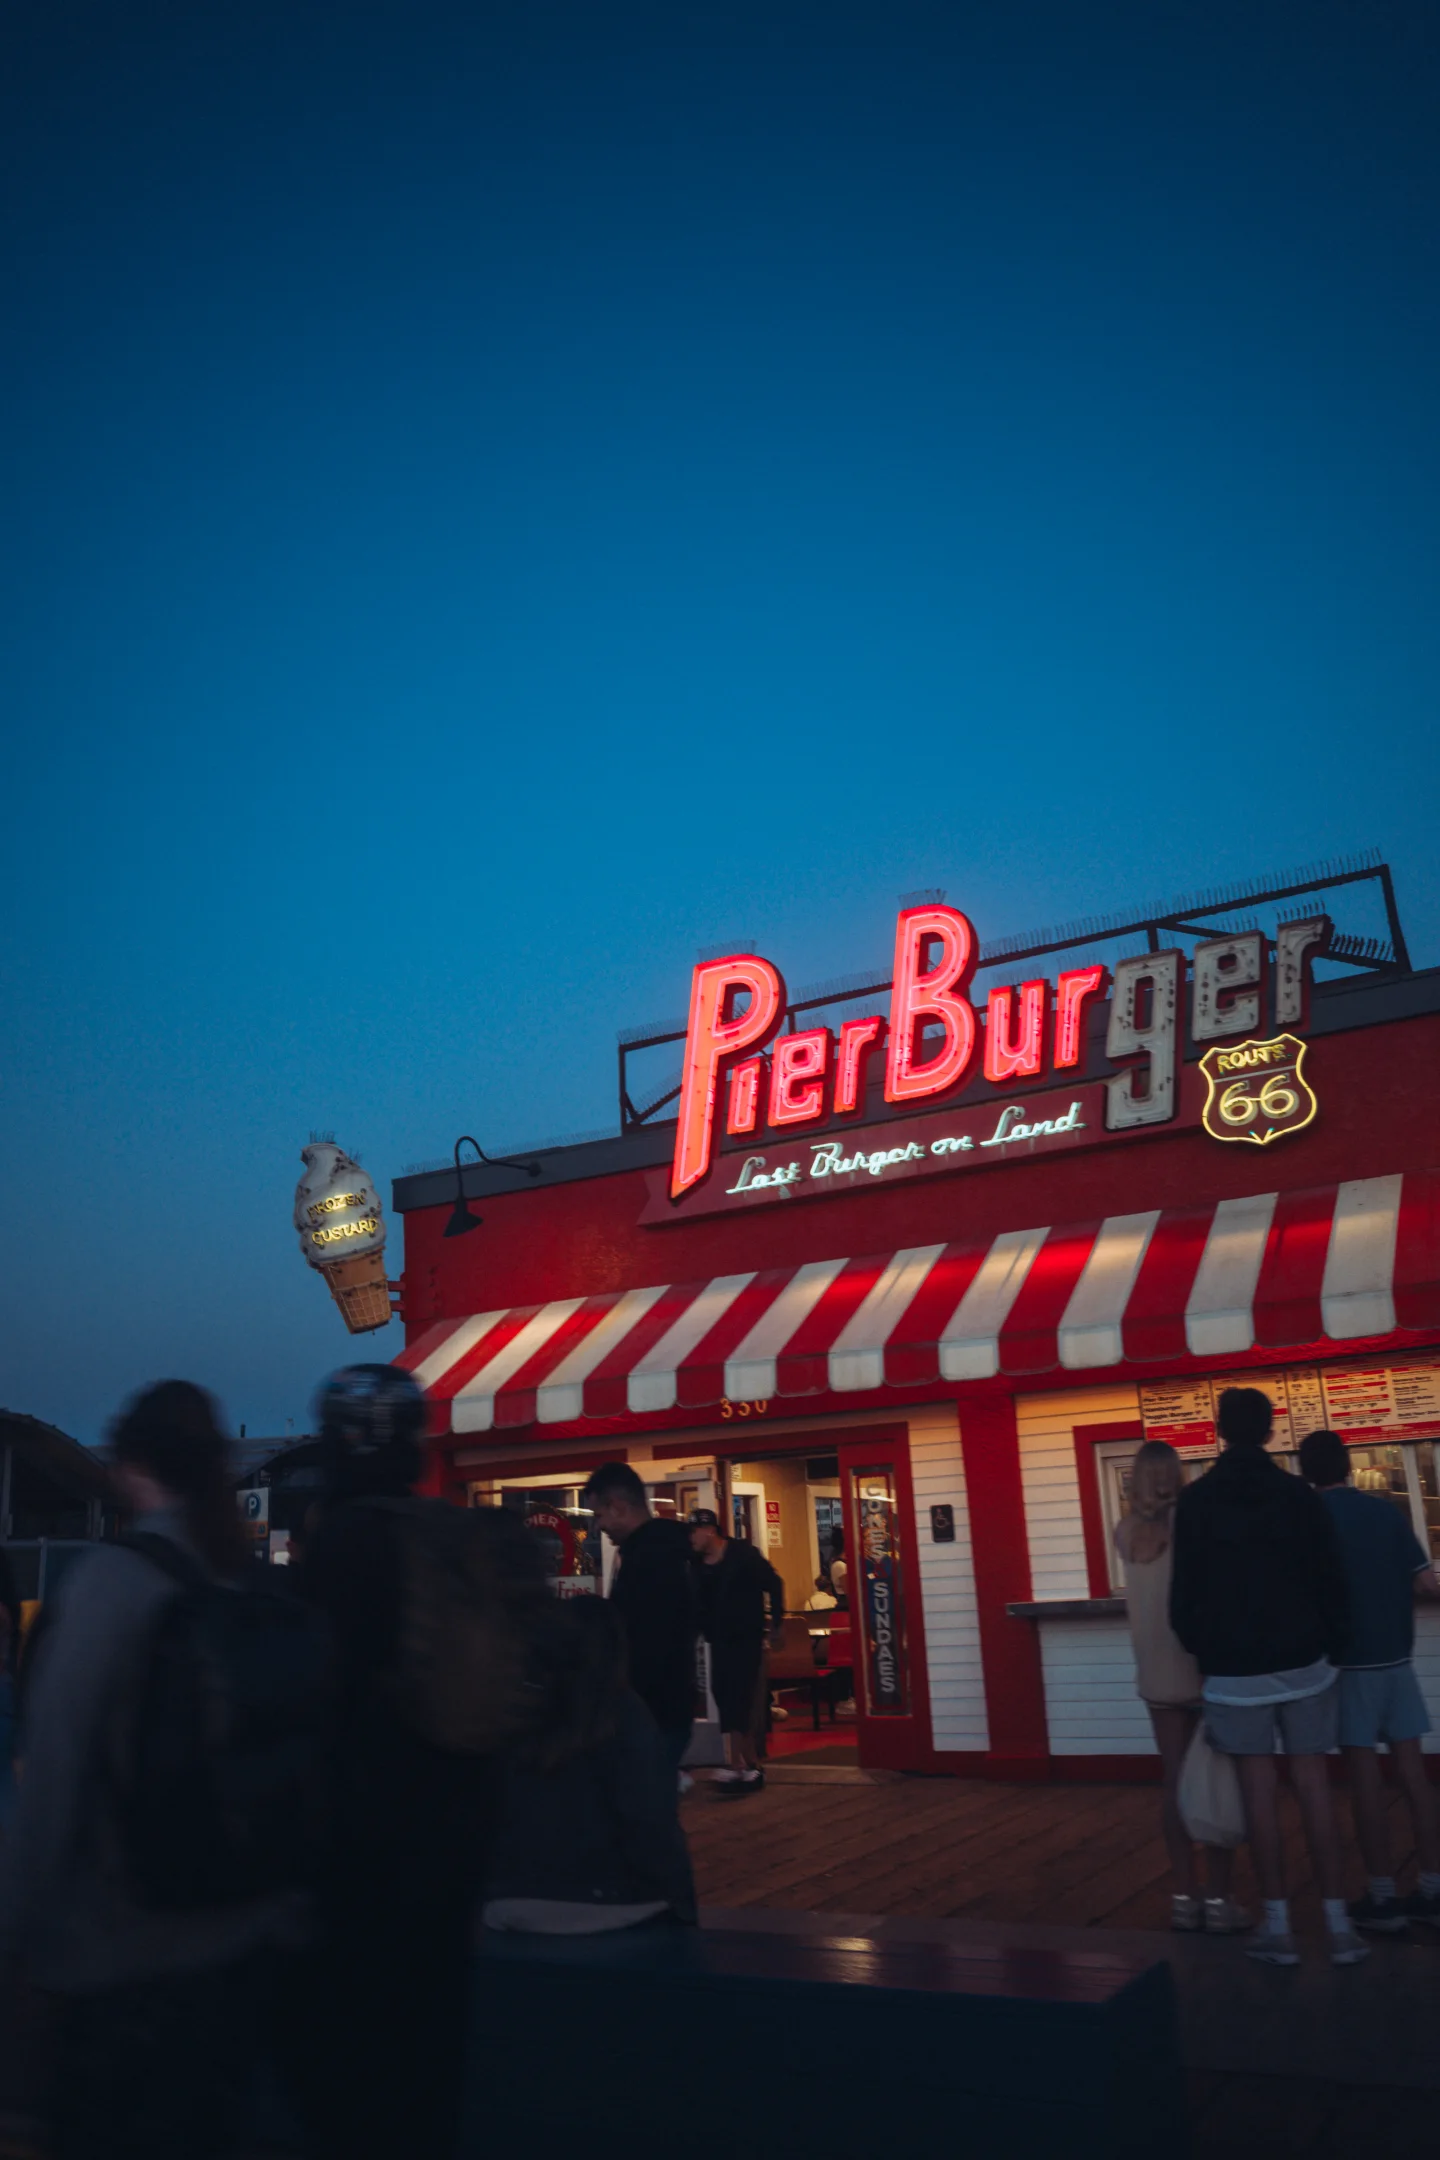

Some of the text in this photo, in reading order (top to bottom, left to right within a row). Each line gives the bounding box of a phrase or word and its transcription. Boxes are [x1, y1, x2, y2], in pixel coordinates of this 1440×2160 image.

[1217, 1044, 1286, 1075] ROUTE
[1219, 1073, 1299, 1126] 66
[725, 1102, 1085, 1194] Last Burger on Land
[307, 1192, 366, 1221] FROZEN
[312, 1218, 379, 1245] CUSTARD
[873, 1582, 896, 1693] SUNDAES
